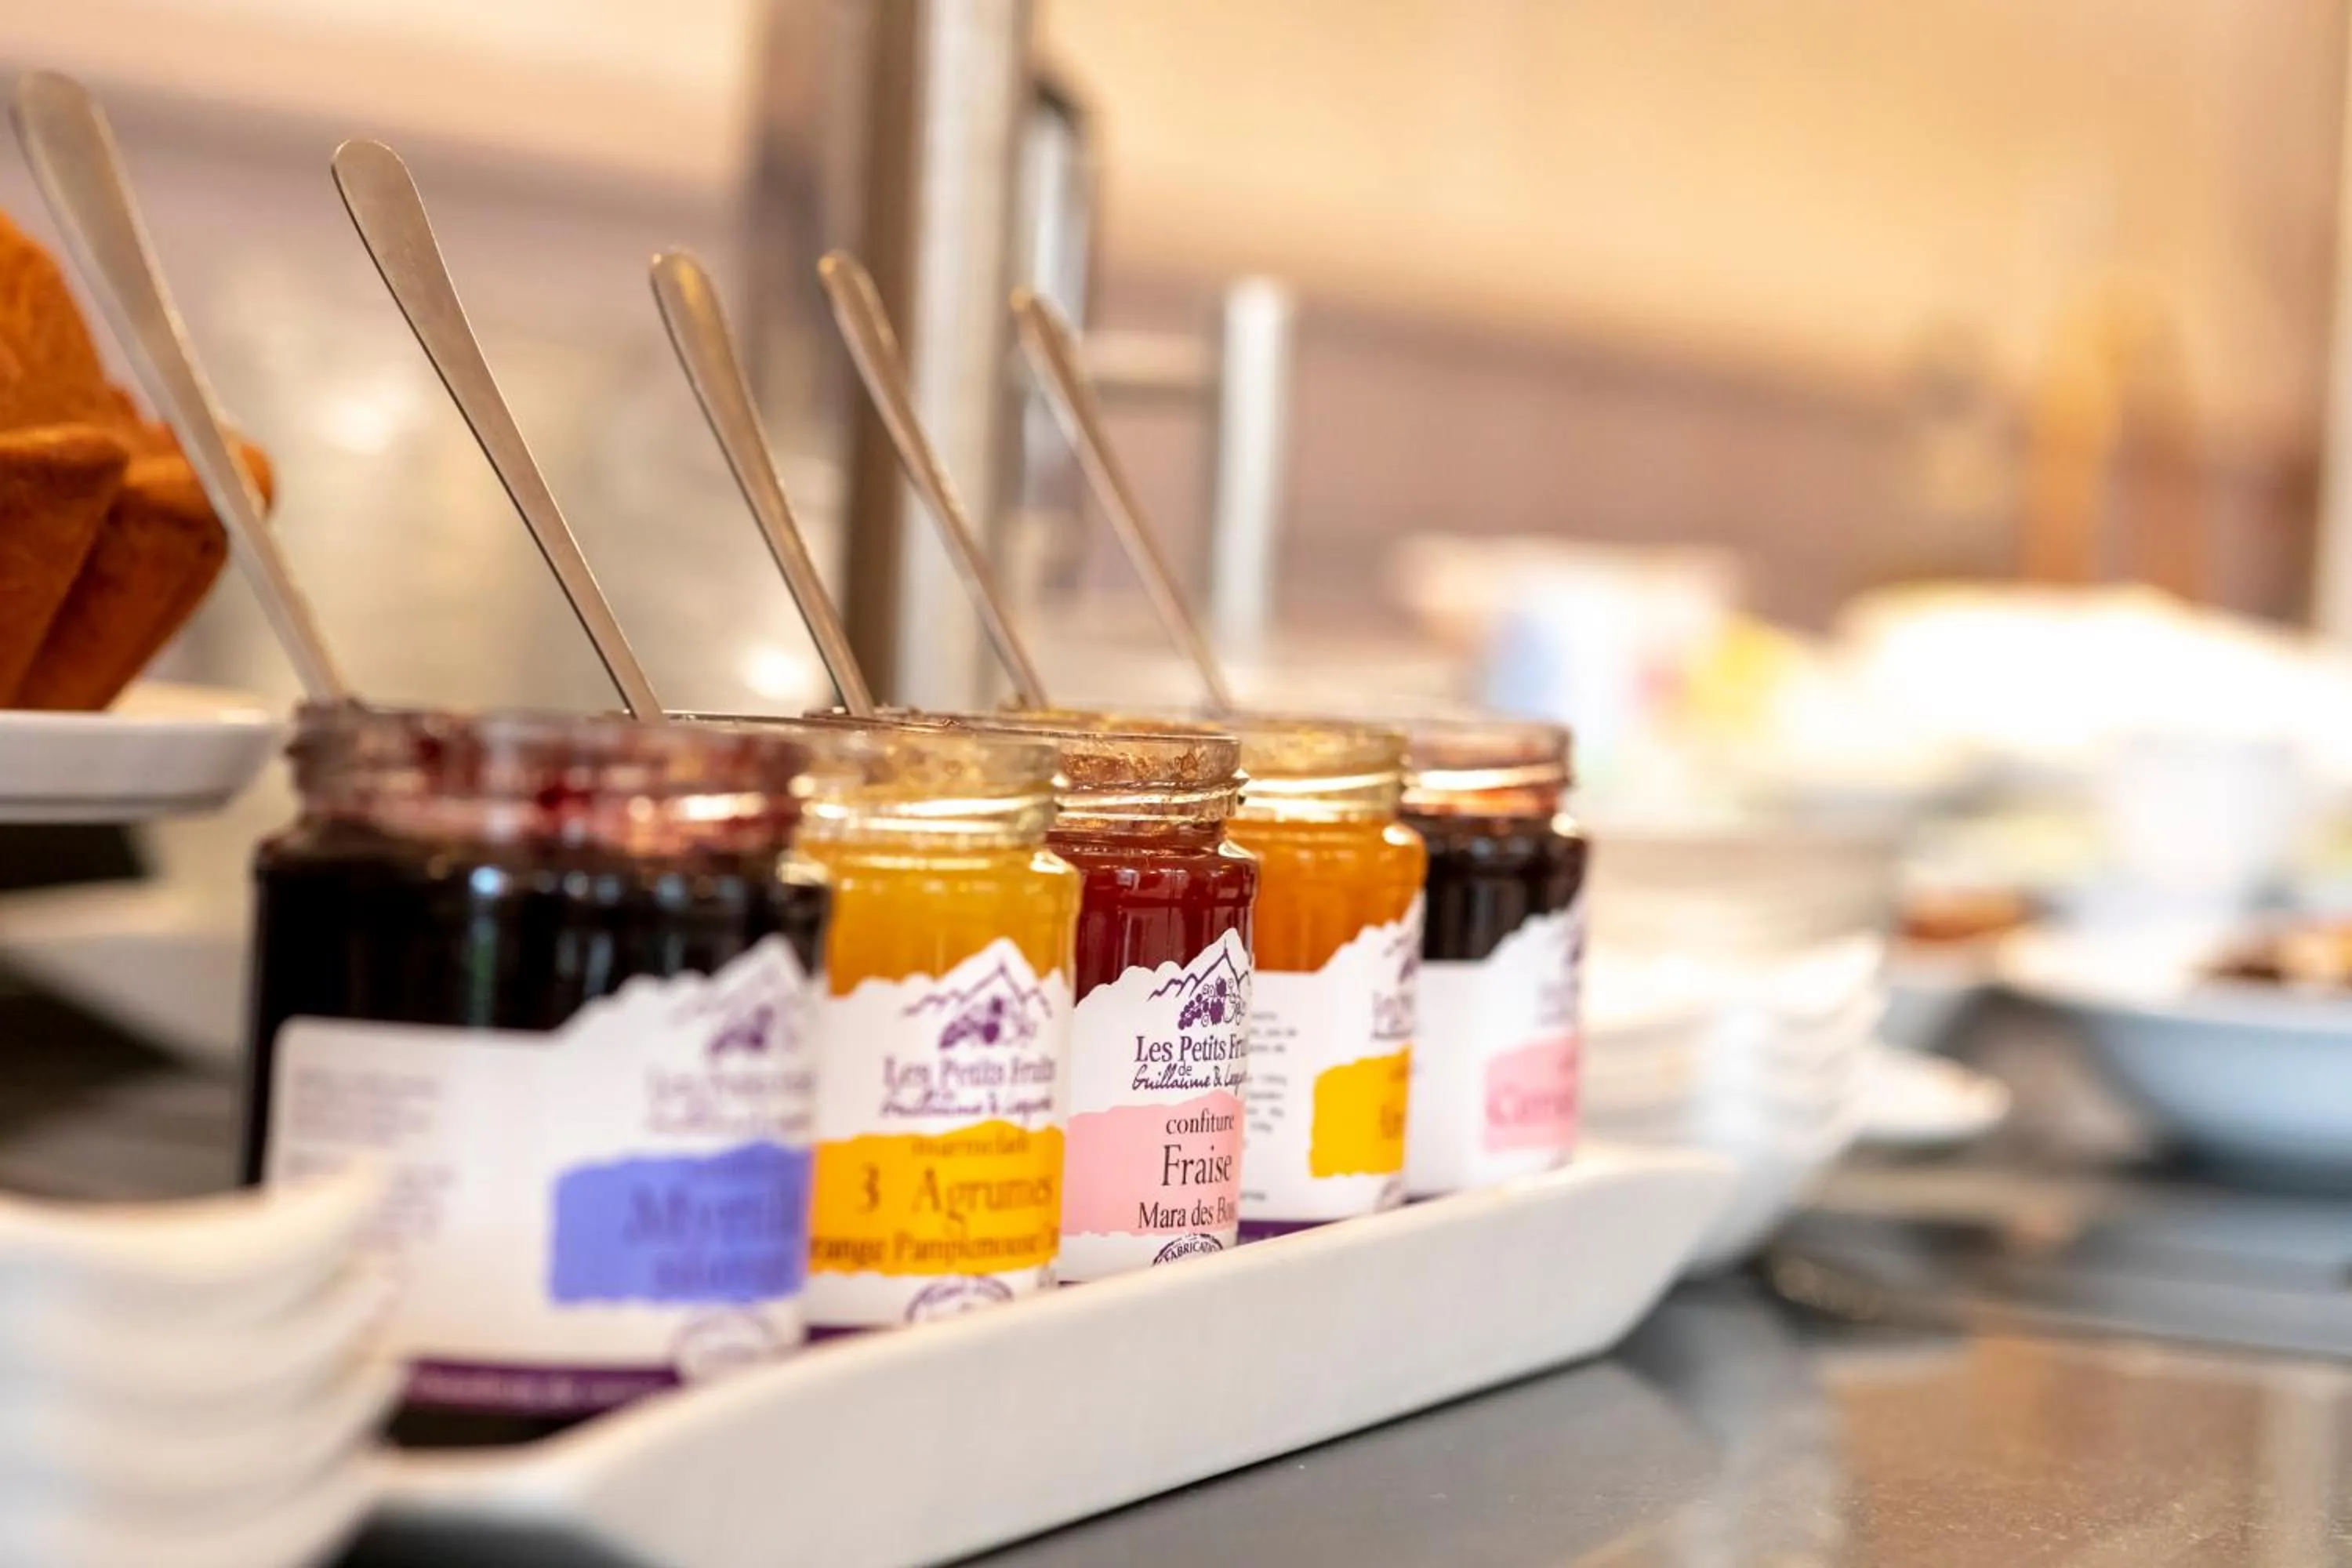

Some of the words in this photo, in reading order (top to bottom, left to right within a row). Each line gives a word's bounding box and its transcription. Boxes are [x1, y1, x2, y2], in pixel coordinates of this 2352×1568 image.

[1134, 1036, 1174, 1062] Les
[1178, 1035, 1226, 1061] Petits
[1132, 1063, 1210, 1091] Guillaume
[1178, 1060, 1192, 1076] de
[1166, 1109, 1236, 1134] confiture
[1162, 1144, 1232, 1186] Fraise
[858, 1163, 880, 1214] 3
[1138, 1201, 1186, 1229] Mara
[1191, 1199, 1214, 1226] des
